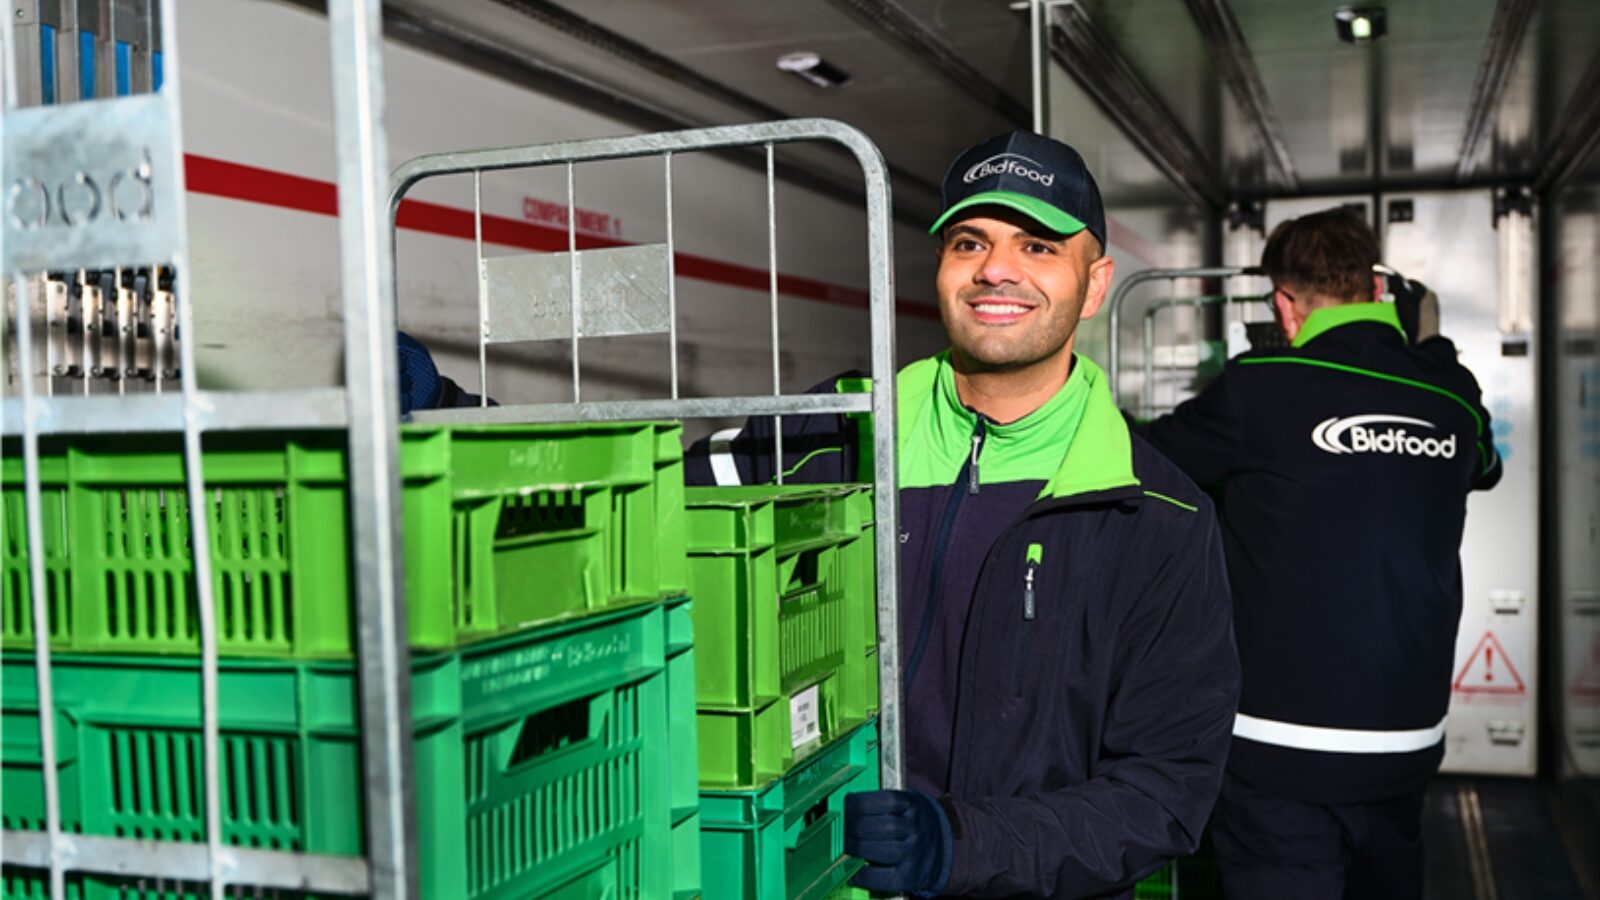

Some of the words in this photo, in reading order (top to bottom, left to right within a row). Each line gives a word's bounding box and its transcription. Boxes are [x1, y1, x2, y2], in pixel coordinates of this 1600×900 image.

[978, 158, 1056, 187] Bidfood
[522, 196, 610, 233] COMPATMENT
[1350, 425, 1456, 459] Bidfood
